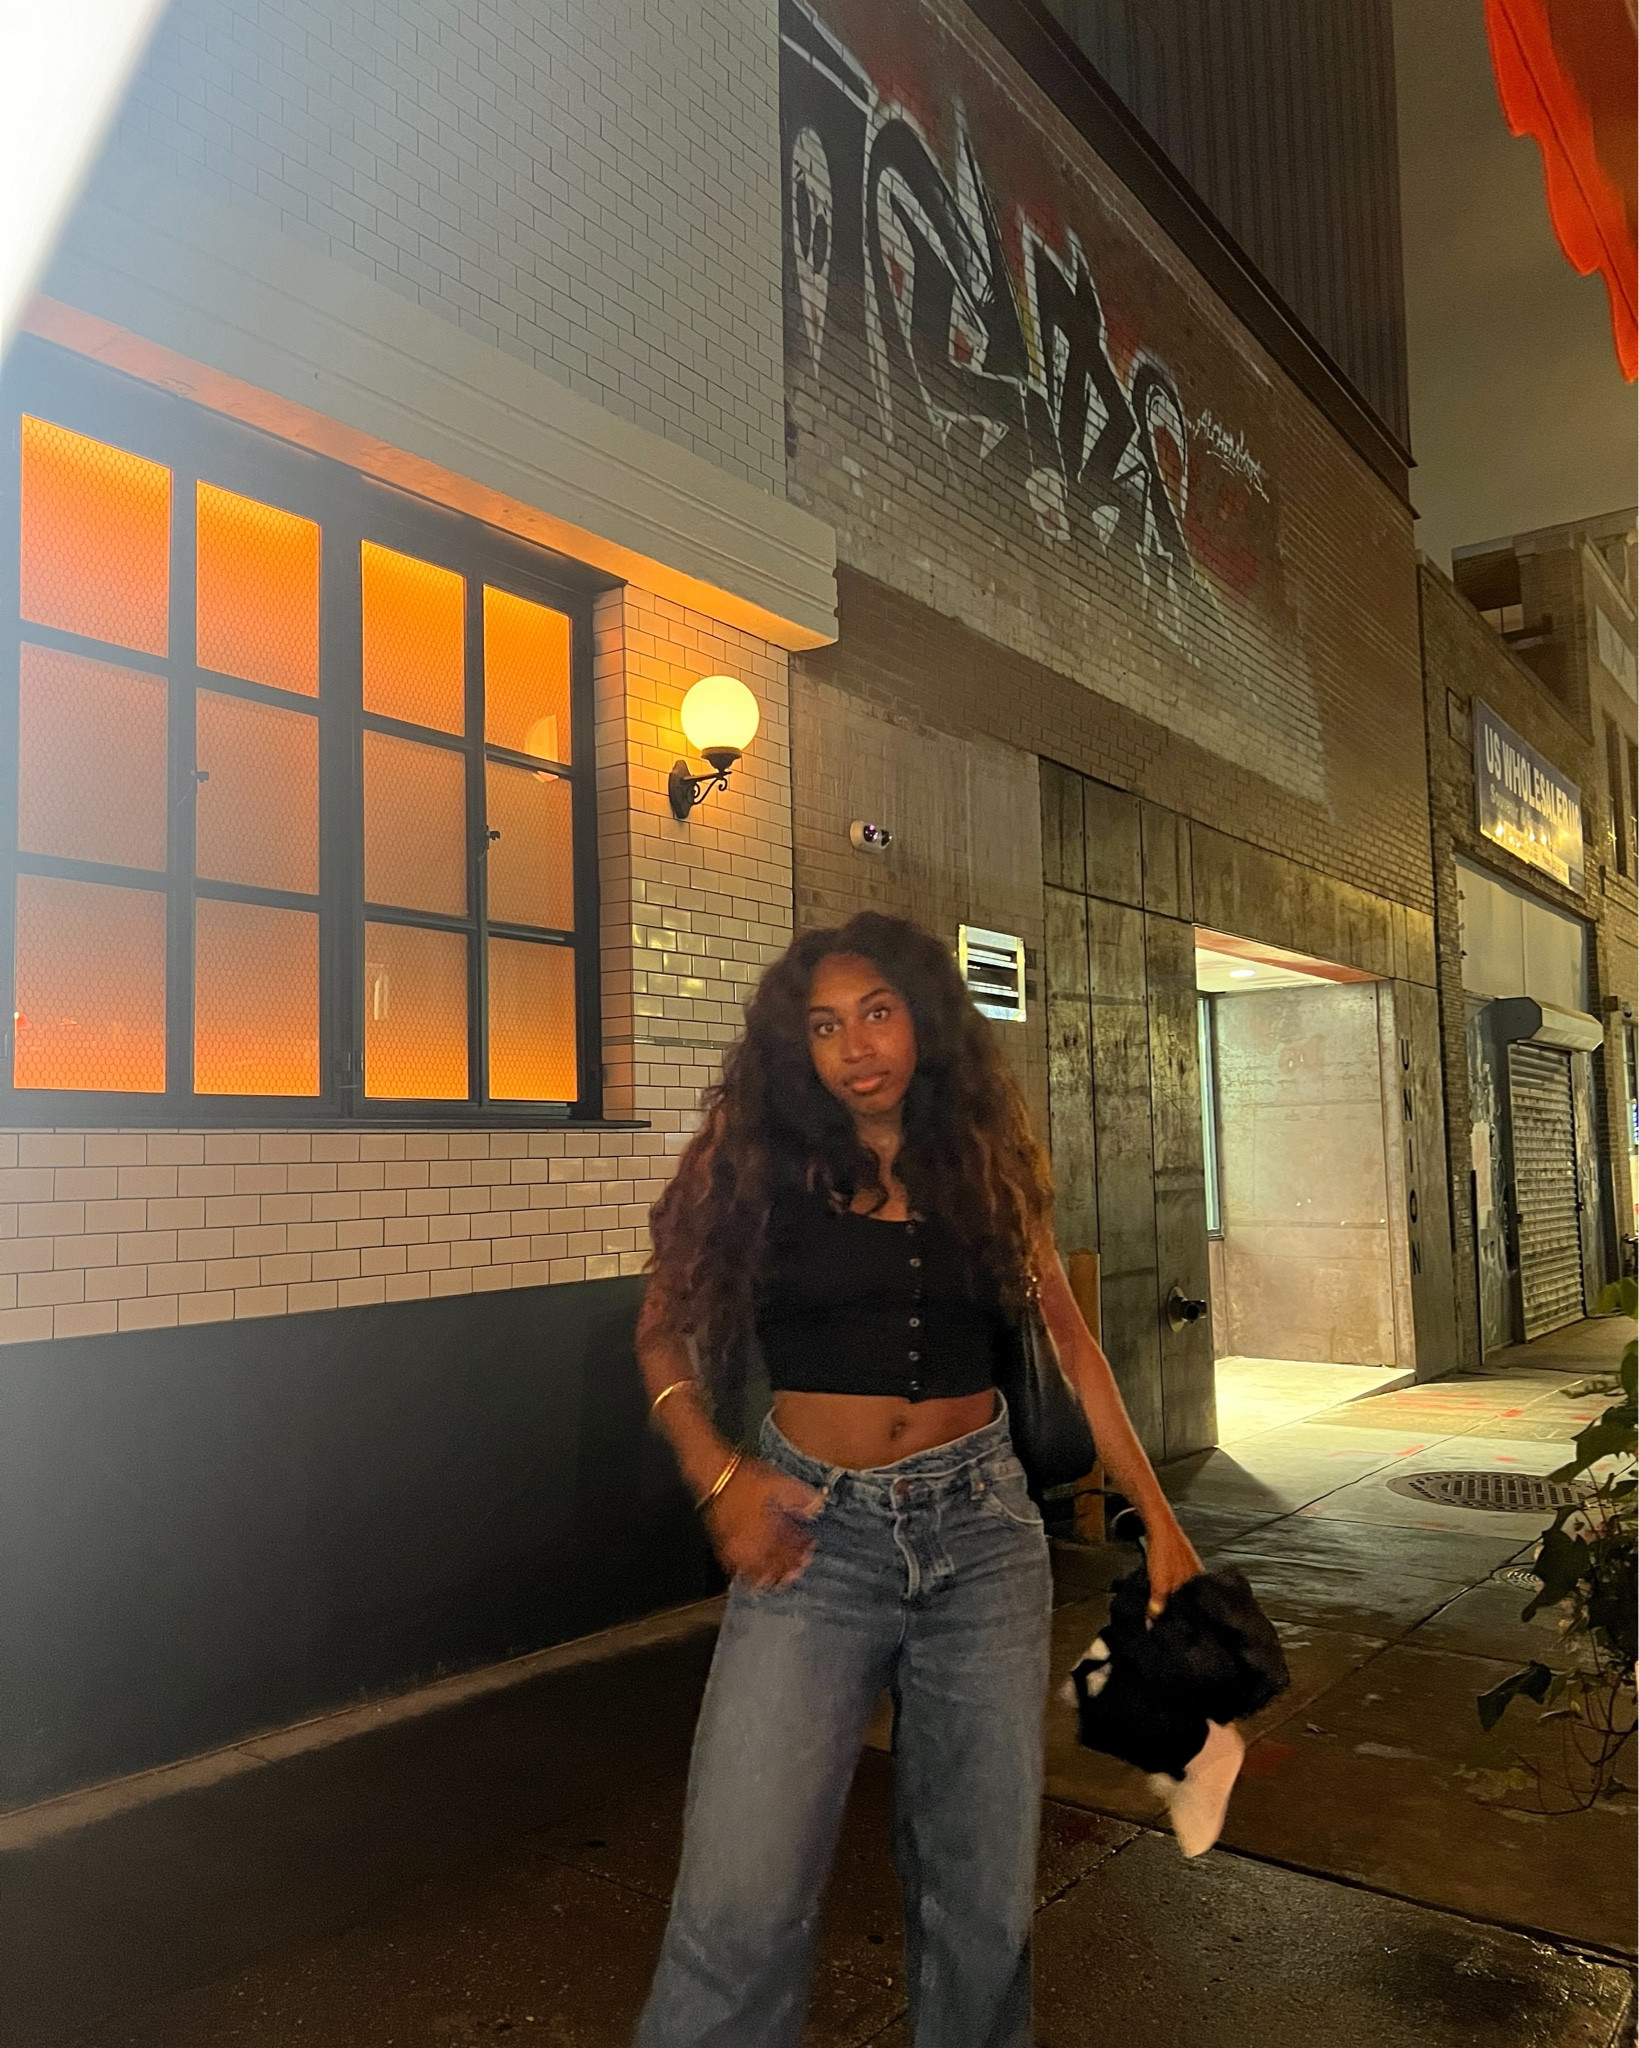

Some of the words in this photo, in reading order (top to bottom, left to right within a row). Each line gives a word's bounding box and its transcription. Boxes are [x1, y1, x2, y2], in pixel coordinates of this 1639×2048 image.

[1485, 724, 1501, 780] US
[1502, 741, 1568, 829] WHOLESALER
[1401, 1039, 1421, 1275] UNION
